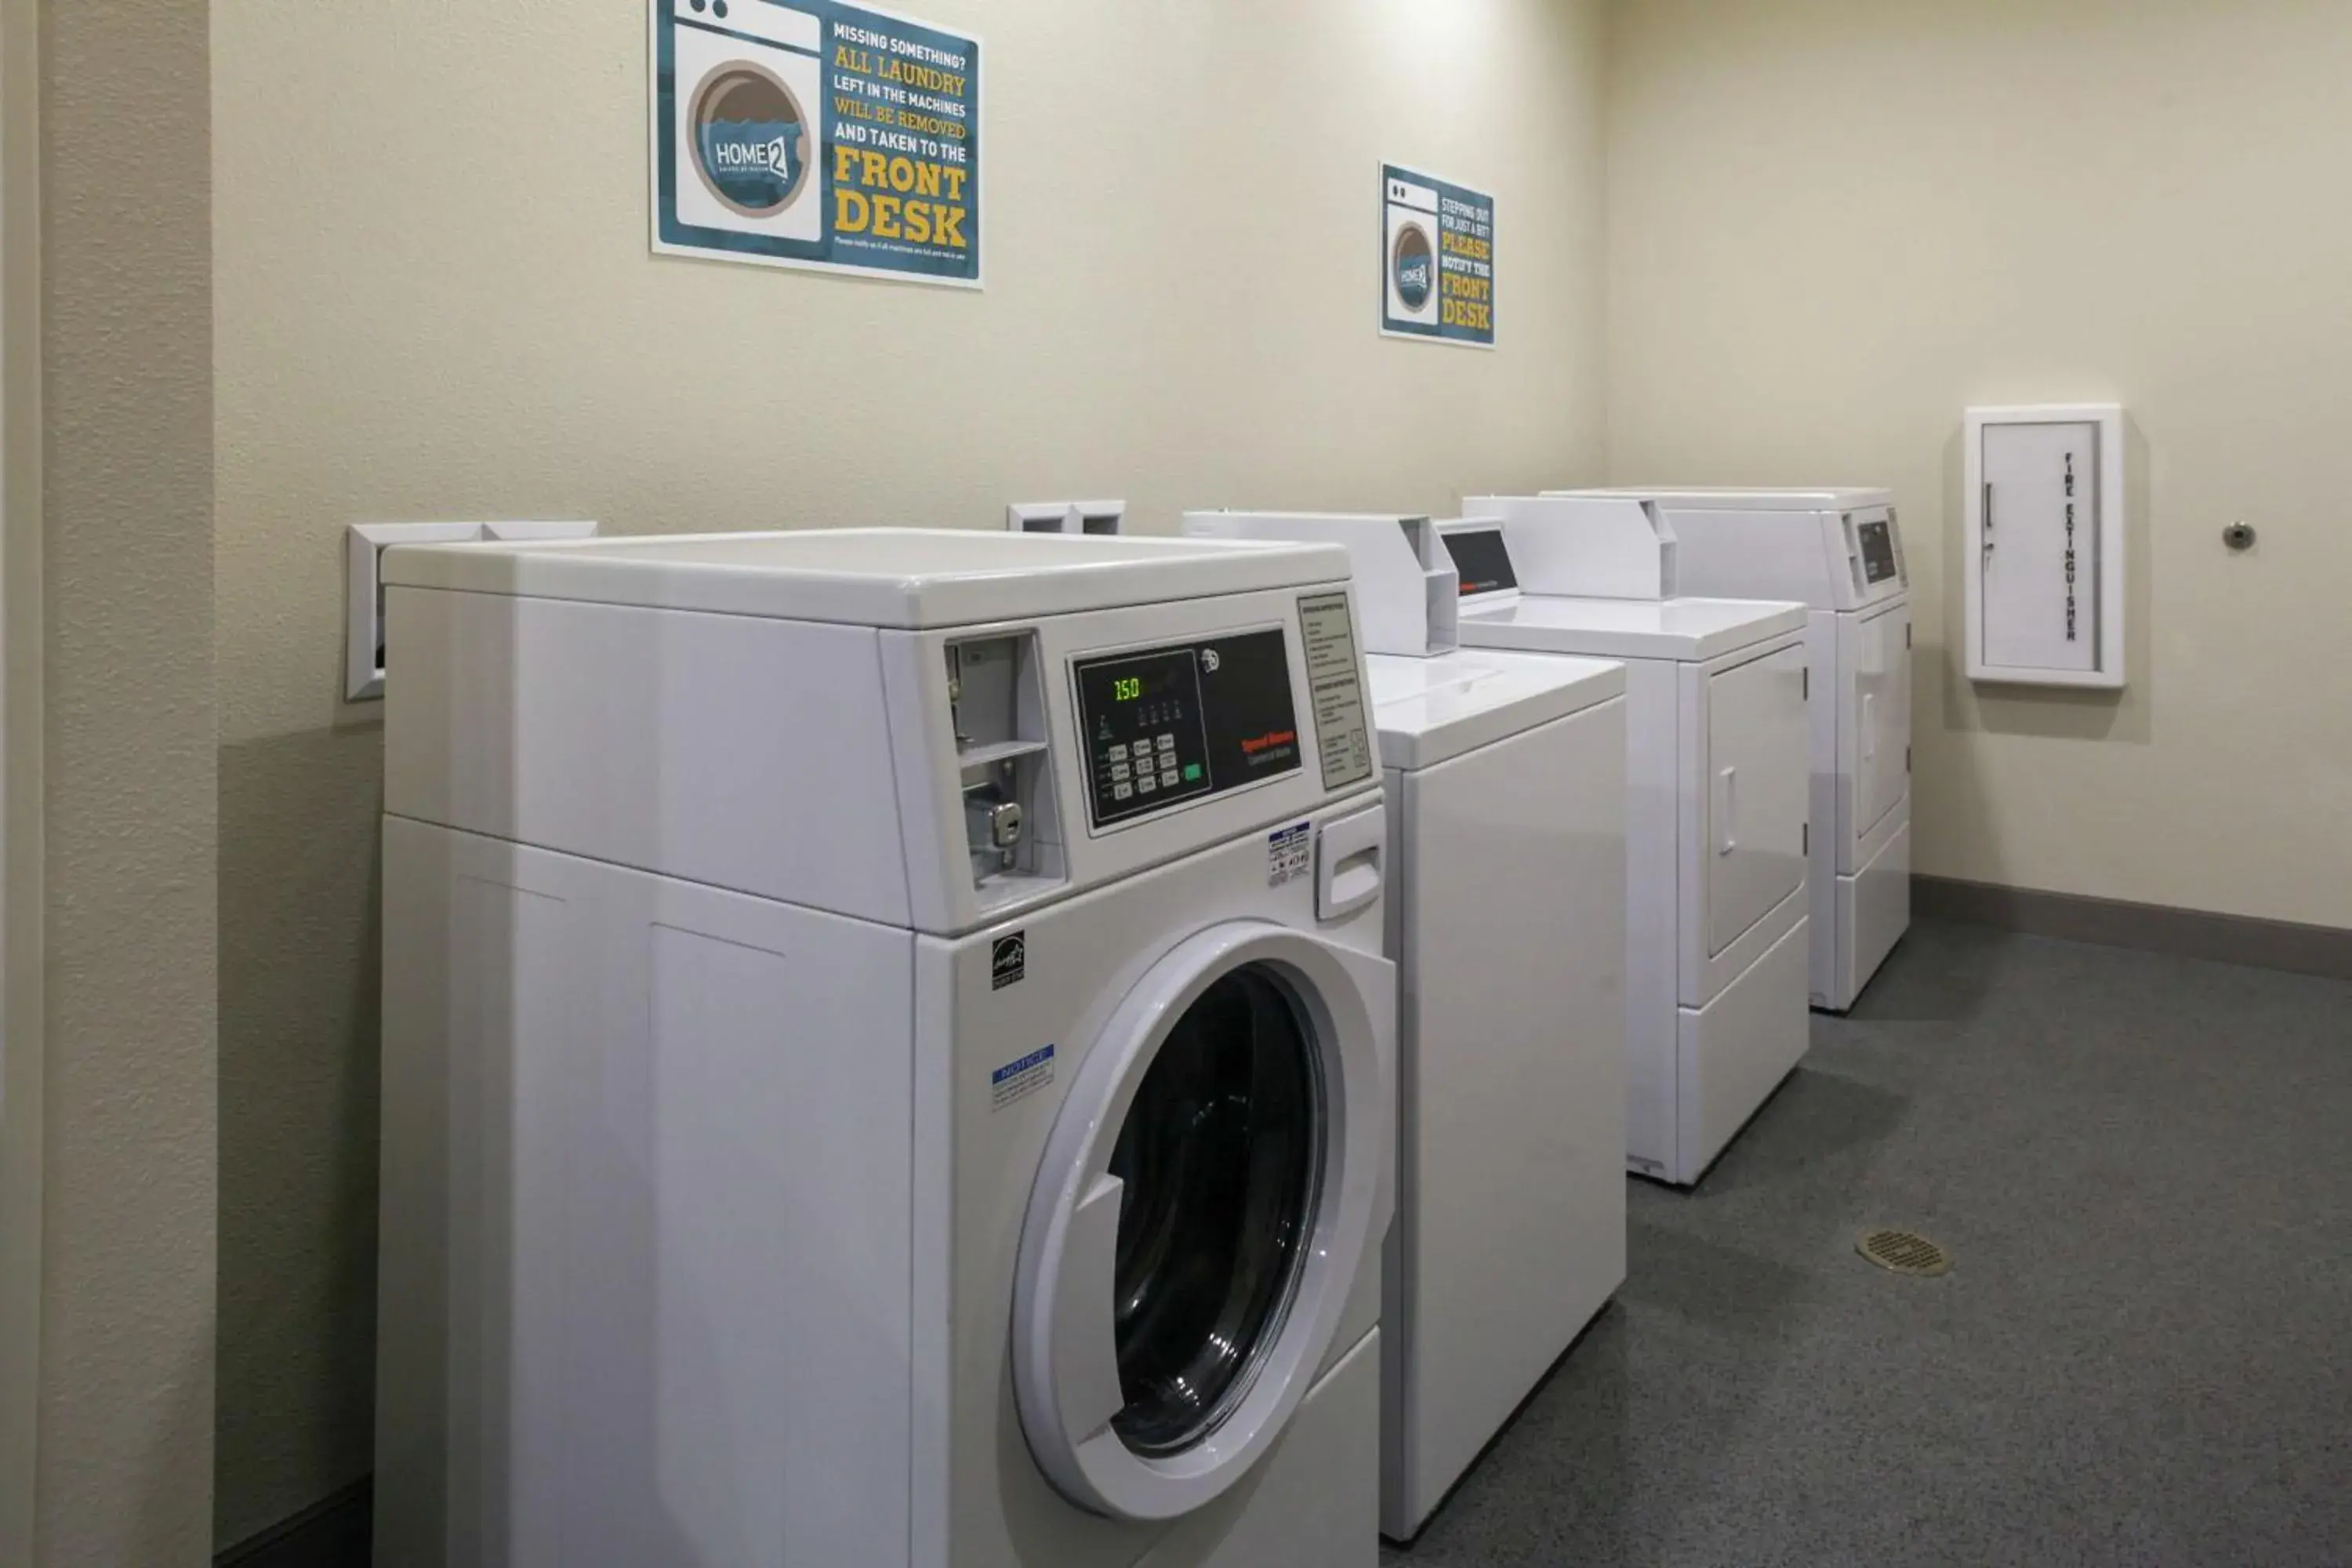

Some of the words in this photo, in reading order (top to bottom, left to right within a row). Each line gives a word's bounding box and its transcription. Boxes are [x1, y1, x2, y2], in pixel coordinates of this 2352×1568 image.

[833, 22, 887, 49] MISSING
[890, 38, 966, 71] SOMETHING?
[835, 45, 872, 74] ALL
[878, 56, 966, 96] LAUNDRY
[833, 74, 865, 95] LEFT
[867, 82, 880, 98] IN
[882, 85, 906, 103] THE
[909, 92, 966, 118] MACHINES
[834, 96, 872, 120] WILL
[877, 106, 894, 124] BE
[898, 111, 966, 140] REMOVED
[835, 122, 866, 142] AND
[869, 128, 916, 153] TAKEN
[920, 138, 938, 157] TO
[940, 143, 966, 162] THE
[834, 145, 967, 201] FRONT
[834, 187, 967, 248] DESK
[1442, 214, 1454, 230] FOR
[1454, 218, 1470, 233] JUST
[1442, 230, 1490, 260] PLEASE
[1442, 272, 1490, 300] FRONT
[1442, 298, 1490, 328] DESK
[2064, 452, 2075, 497] FIRE
